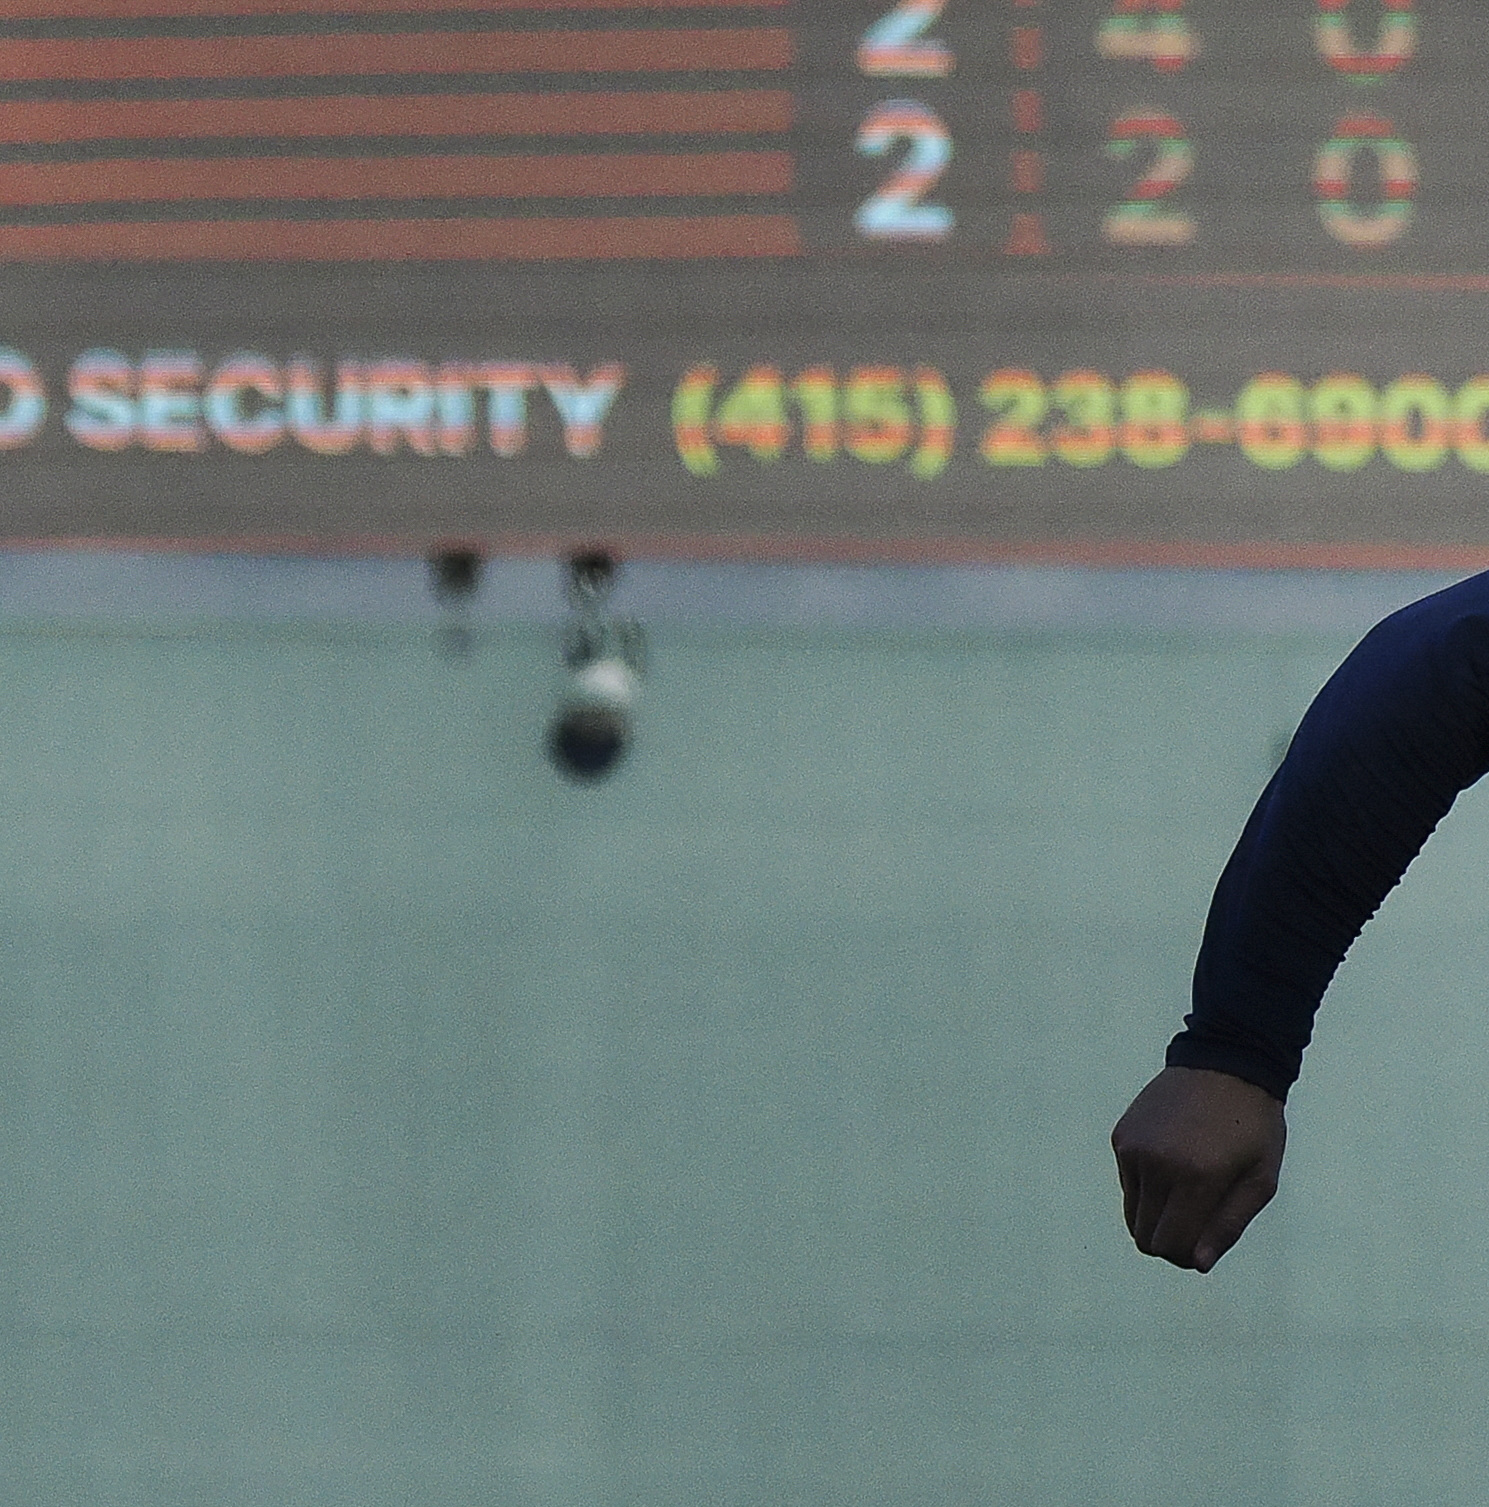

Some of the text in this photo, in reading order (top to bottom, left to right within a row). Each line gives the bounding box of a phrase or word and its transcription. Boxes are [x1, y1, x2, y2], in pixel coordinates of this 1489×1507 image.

[854, 99, 954, 240] 2
[1104, 107, 1192, 247] 2
[1315, 112, 1419, 250] 0
[64, 347, 625, 457] SECURITY
[673, 362, 954, 479] (415)
